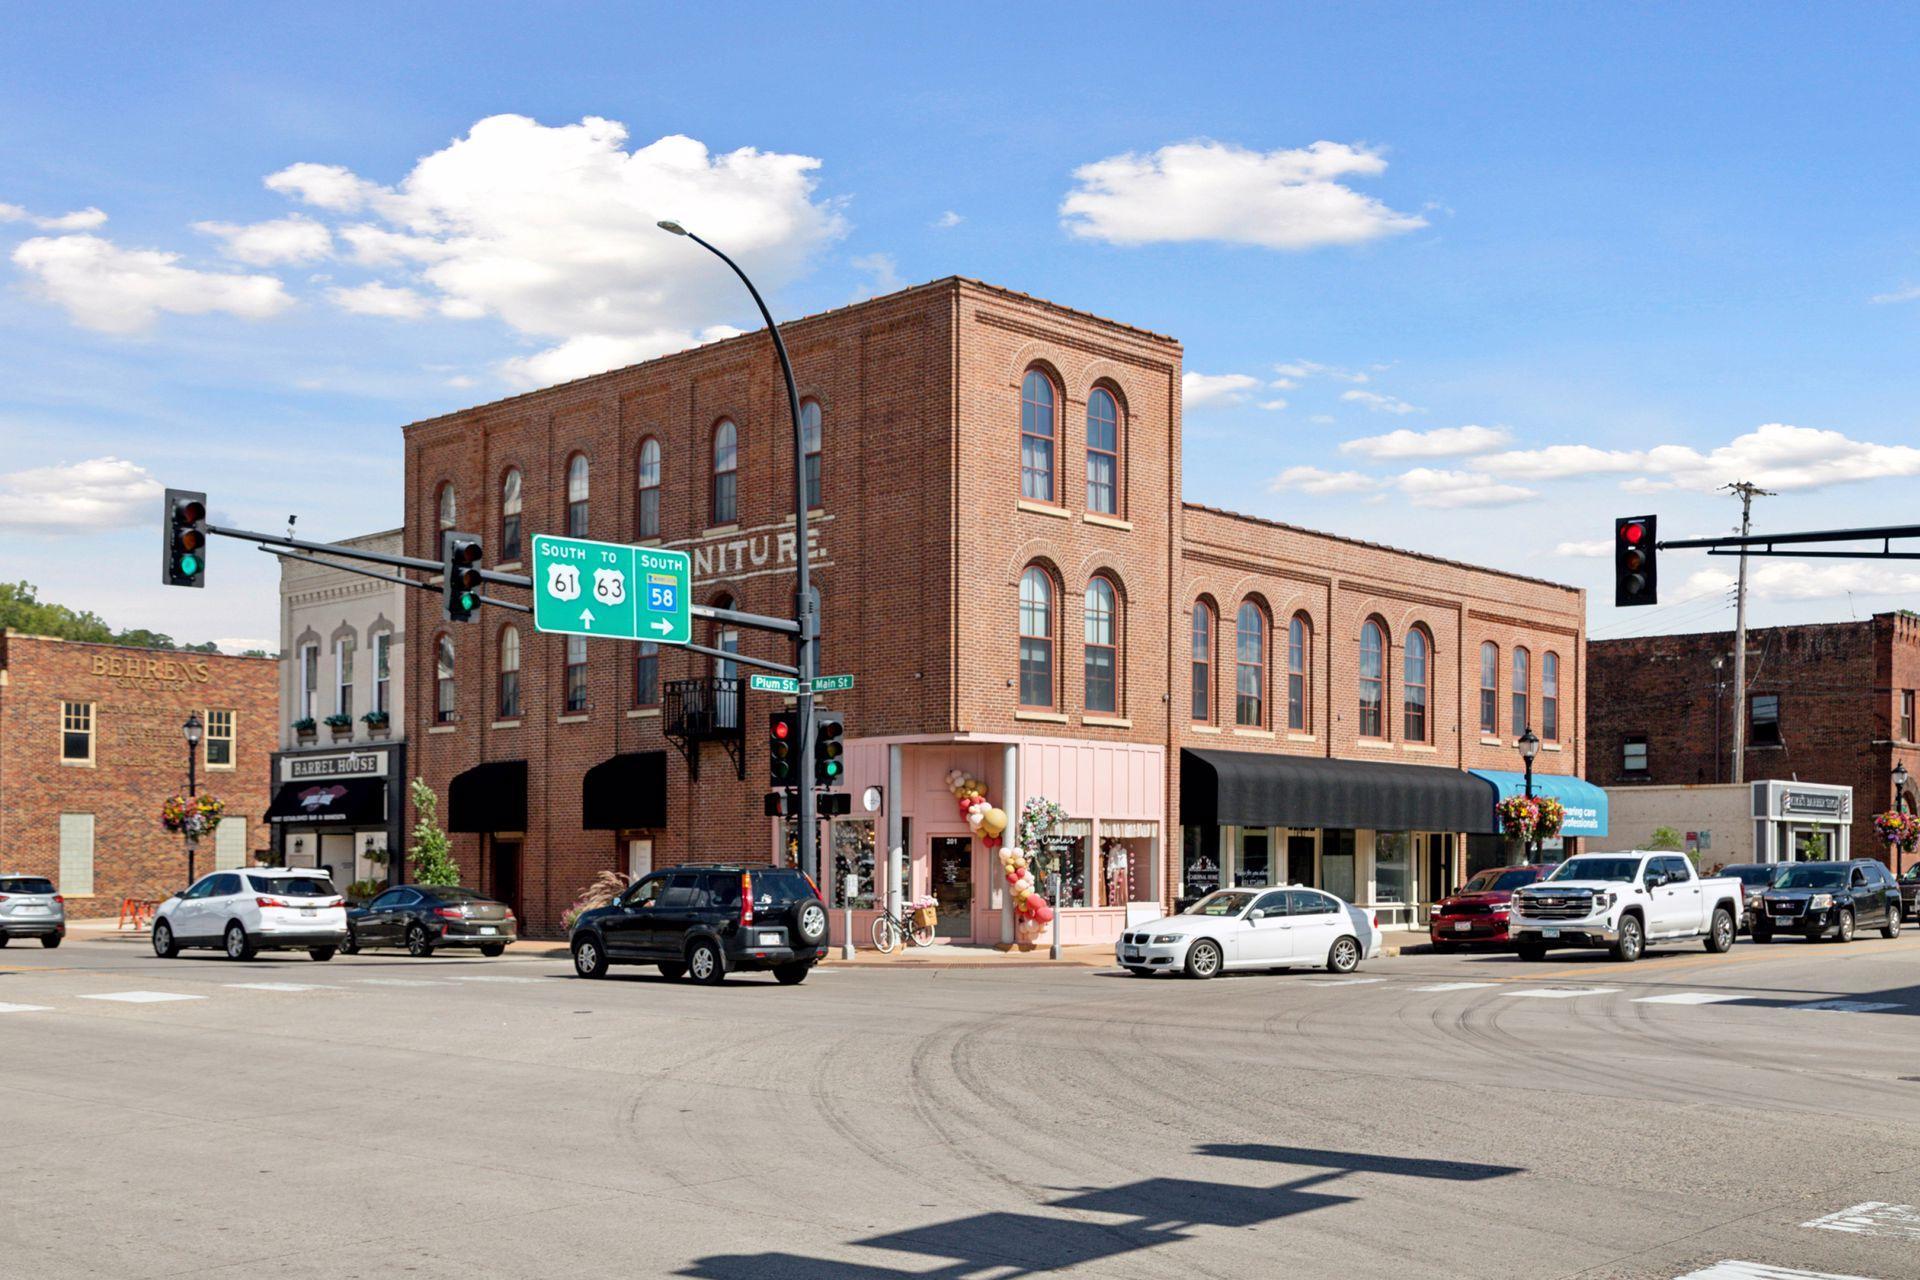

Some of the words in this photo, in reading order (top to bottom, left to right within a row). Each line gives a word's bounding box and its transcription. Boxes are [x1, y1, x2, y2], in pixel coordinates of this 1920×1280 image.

[541, 542, 586, 560] SOUTH
[601, 551, 617, 564] TO
[693, 528, 828, 577] NITURE.
[641, 555, 683, 571] SOUTH
[555, 573, 574, 593] 61
[597, 578, 622, 598] 63
[651, 588, 673, 607] 58
[91, 654, 209, 684] BEHRENS
[756, 677, 781, 689] Plum
[783, 680, 793, 690] St
[816, 679, 836, 689] Main
[838, 677, 848, 687] St
[294, 760, 336, 776] BARREL
[338, 757, 376, 773] HOUSE
[1563, 806, 1583, 818] earing
[1584, 808, 1596, 817] care
